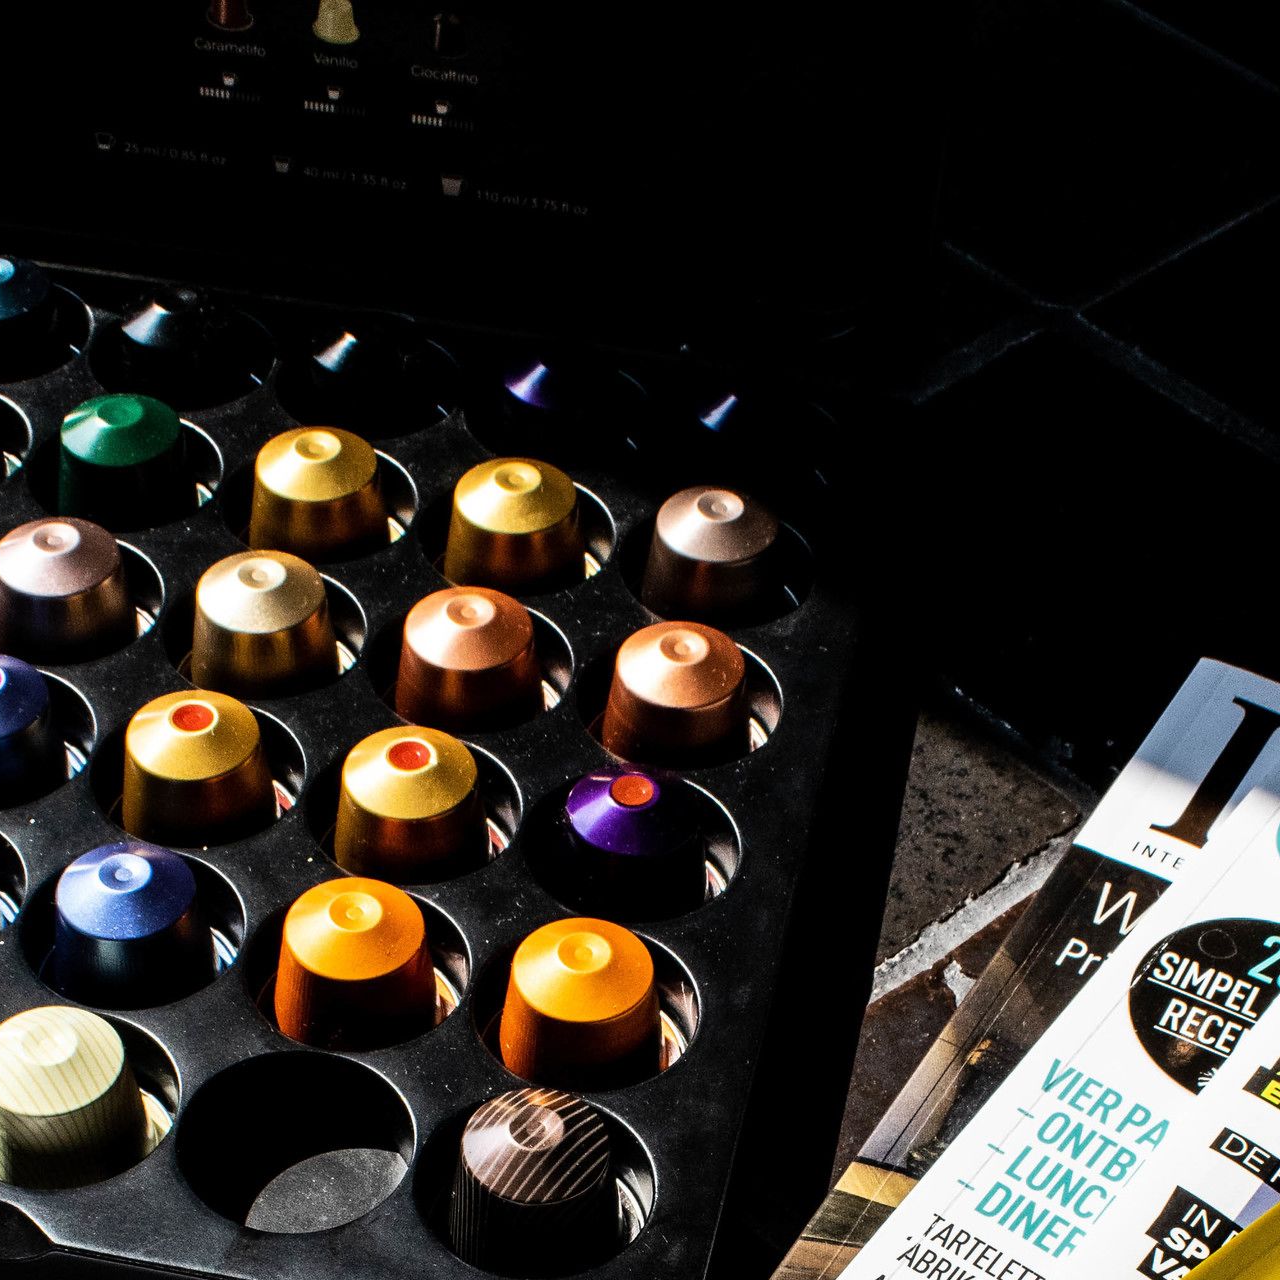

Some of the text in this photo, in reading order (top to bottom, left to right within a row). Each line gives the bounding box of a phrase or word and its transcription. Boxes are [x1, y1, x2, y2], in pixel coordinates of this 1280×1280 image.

[1152, 951, 1261, 1018] SIMPEL
[1041, 1058, 1123, 1124] VIER
[1220, 1133, 1271, 1173] DE
[1182, 1203, 1221, 1237] IN
